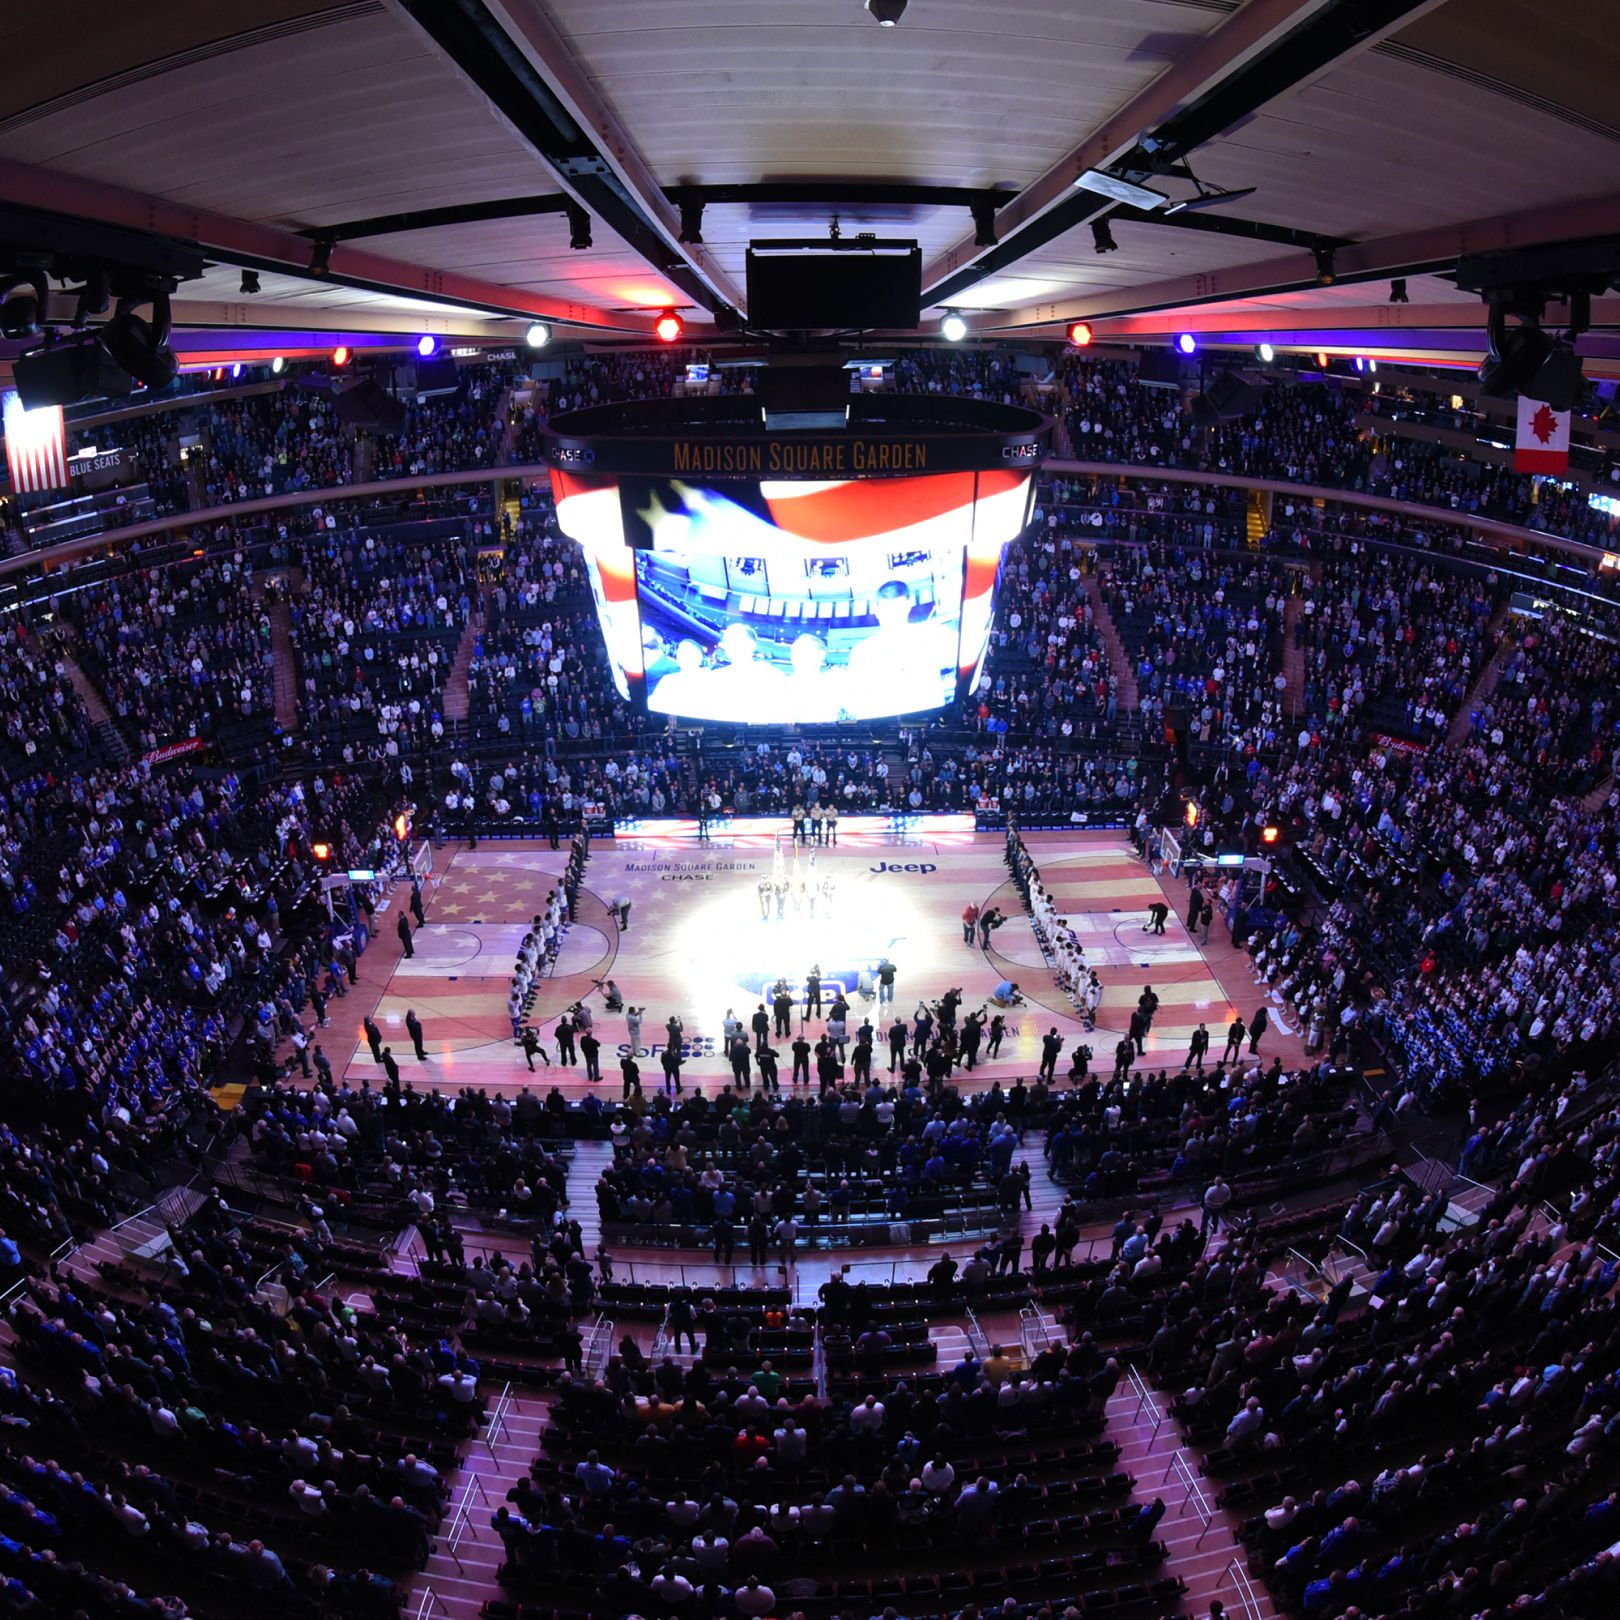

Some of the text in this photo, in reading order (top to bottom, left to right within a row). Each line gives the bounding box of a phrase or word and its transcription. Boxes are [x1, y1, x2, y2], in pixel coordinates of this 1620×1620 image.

[552, 447, 581, 461] CHASE
[674, 441, 926, 472] MADISON SQUARE GARDEN
[1002, 444, 1038, 458] CHASE
[69, 454, 120, 477] BLUE SEATS
[145, 741, 199, 763] Budweiser
[625, 862, 756, 872] MADISON SQUARE GARDEN
[870, 862, 937, 874] Jeep
